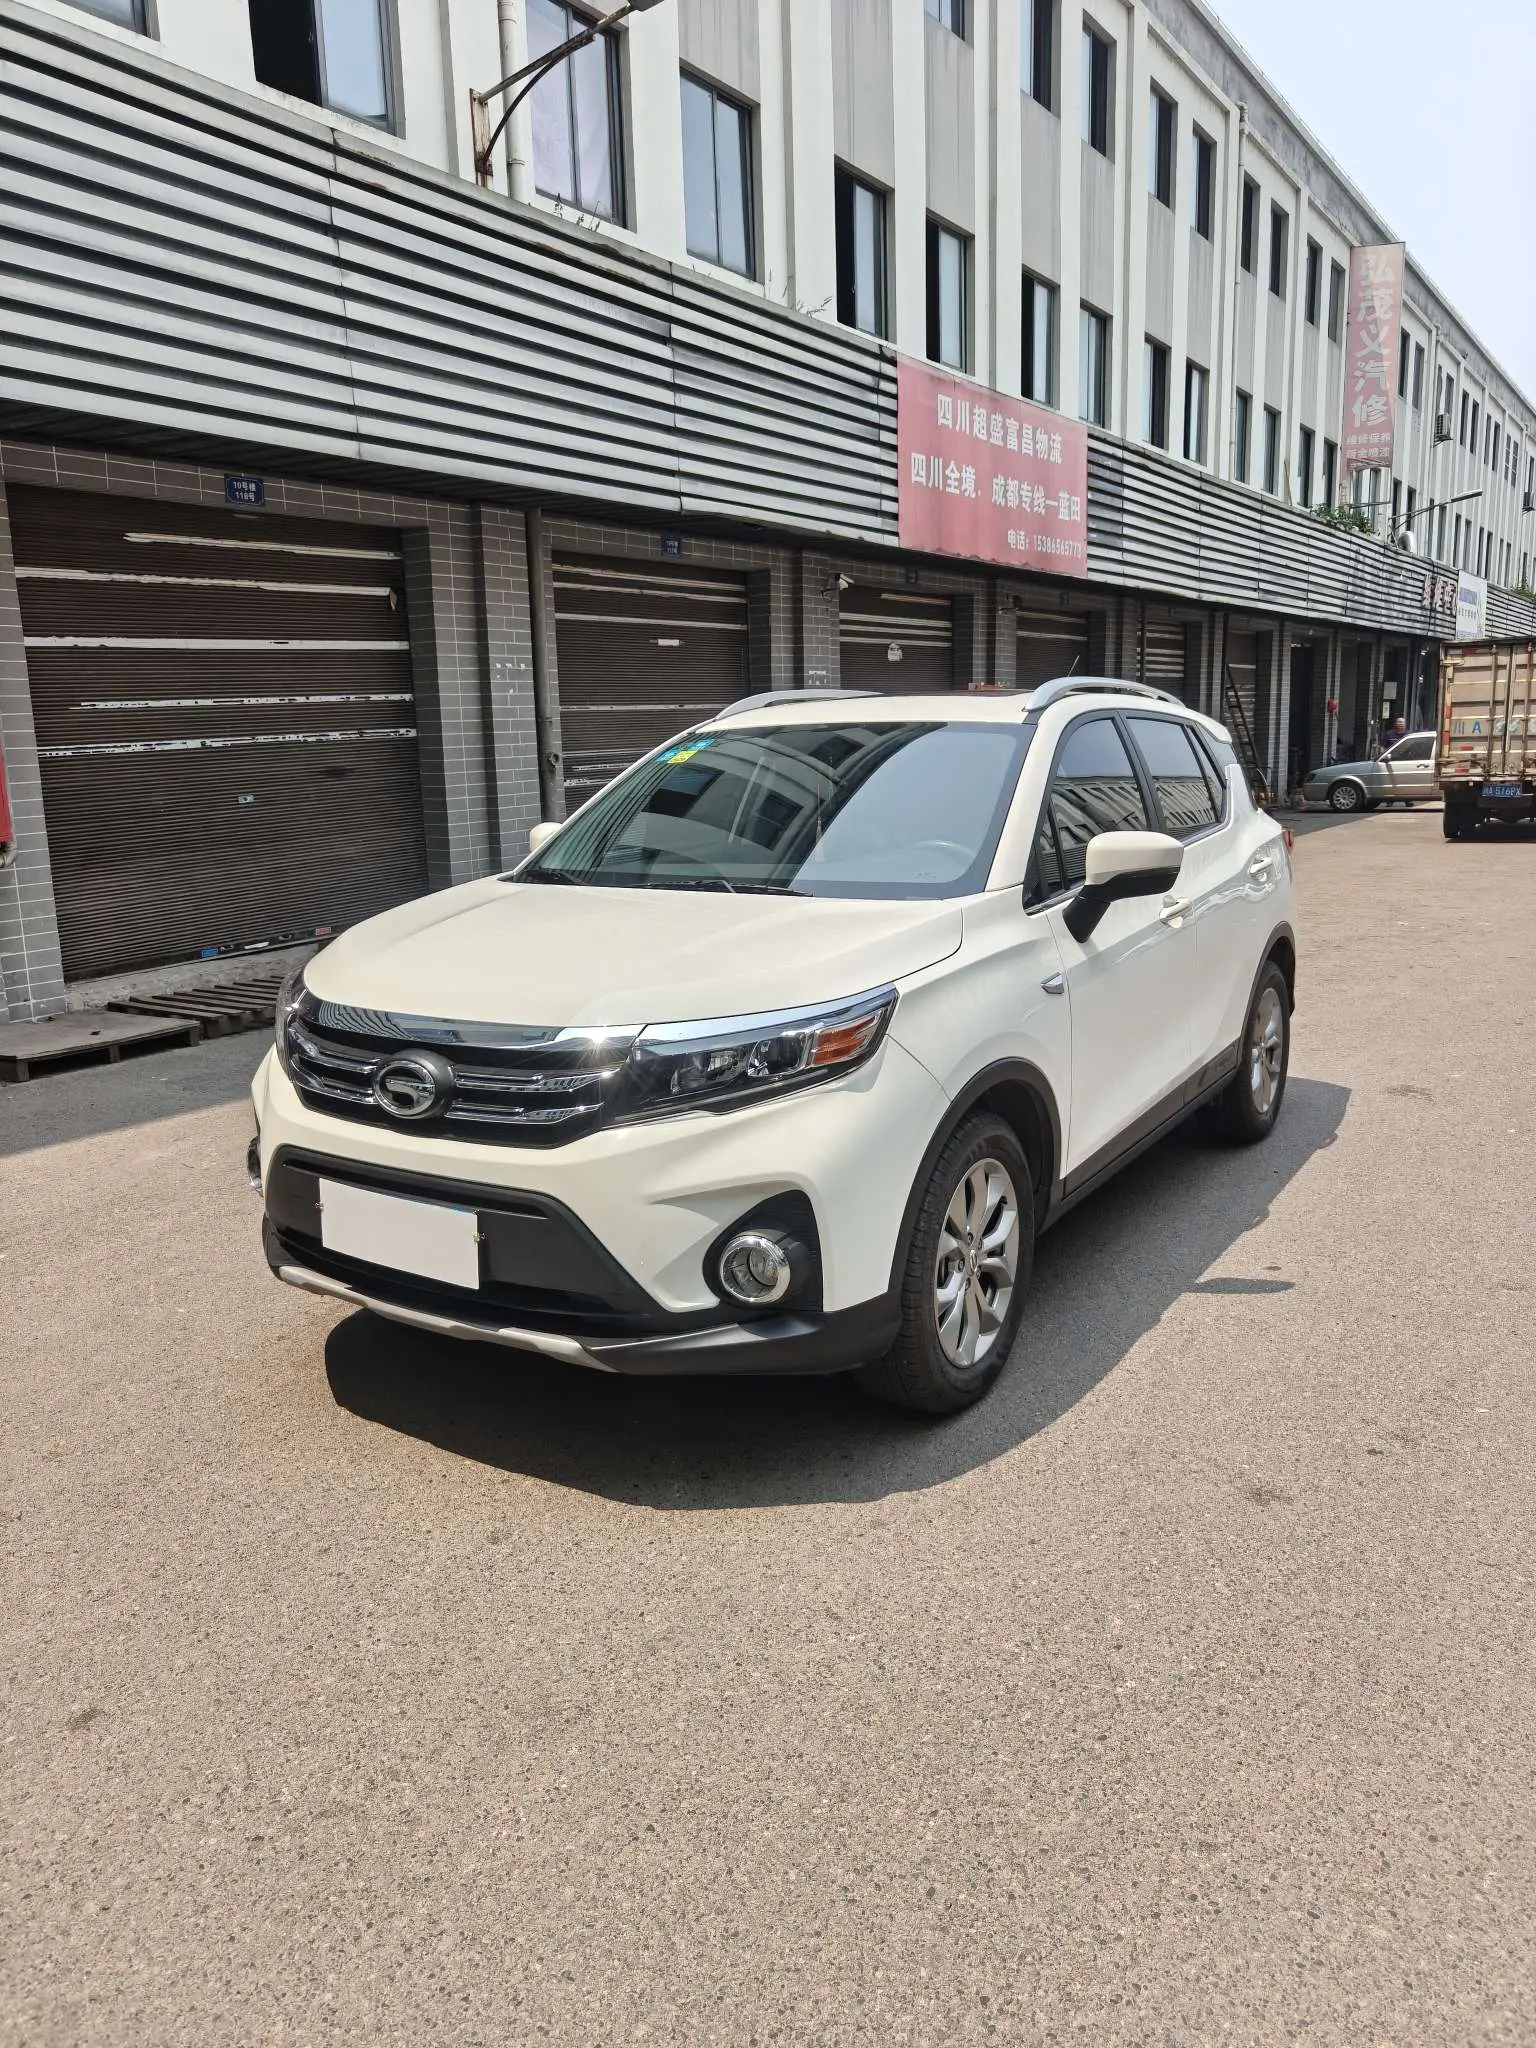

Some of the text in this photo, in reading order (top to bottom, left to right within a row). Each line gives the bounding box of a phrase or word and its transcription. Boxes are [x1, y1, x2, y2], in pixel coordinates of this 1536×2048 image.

[936, 393, 1062, 465] 四川超盛富昌物流
